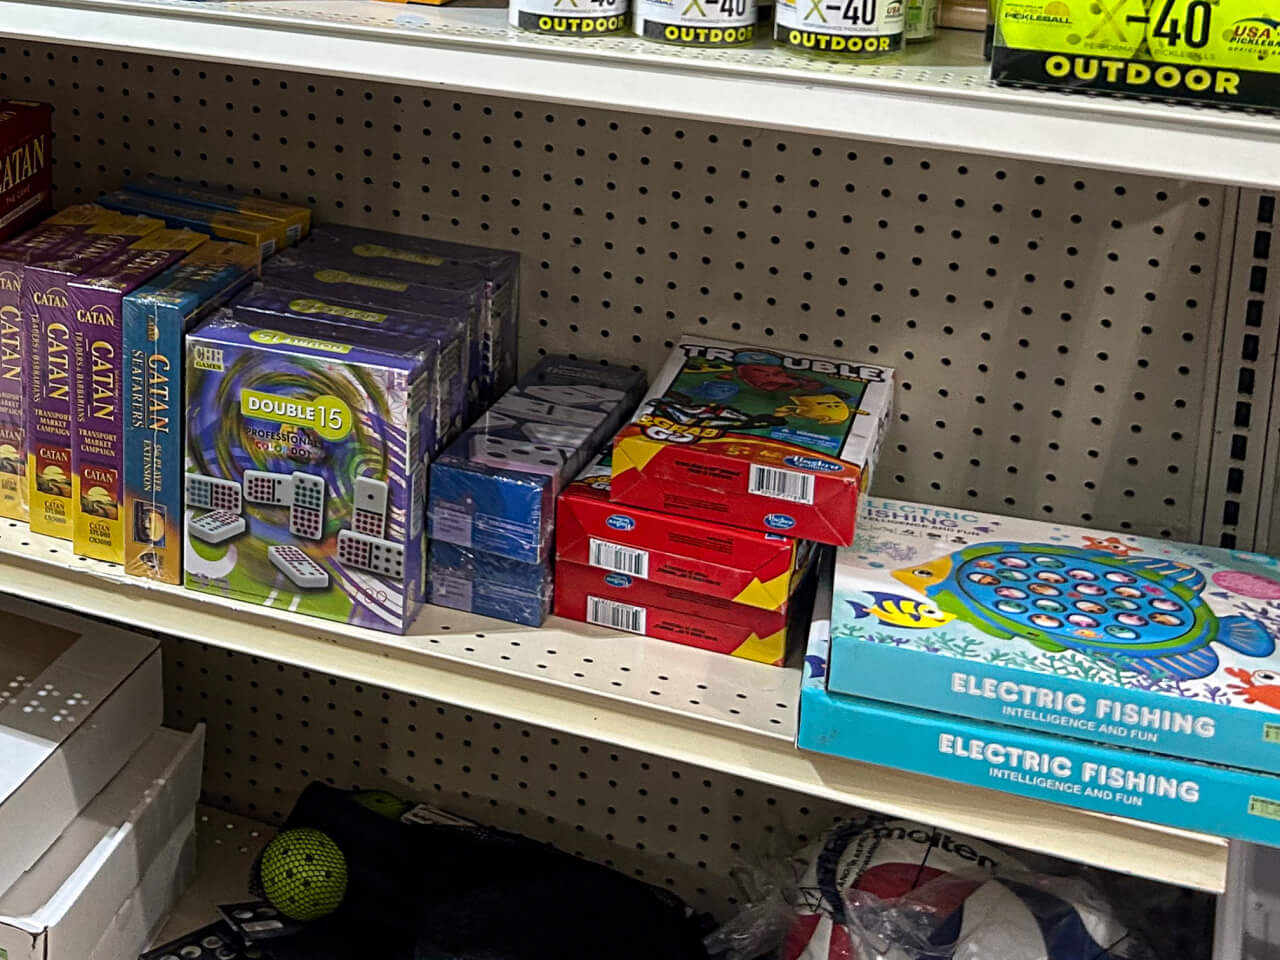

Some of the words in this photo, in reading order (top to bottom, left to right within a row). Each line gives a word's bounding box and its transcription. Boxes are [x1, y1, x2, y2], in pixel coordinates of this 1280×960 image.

[789, 30, 890, 52] OUTDOOR
[1045, 55, 1241, 96] OUTDOOR
[76, 309, 115, 327] CATAN
[0, 305, 21, 381] CATAN
[47, 322, 69, 401] CATAN
[90, 340, 115, 422] CATAN
[131, 349, 144, 429] SEAFARERS
[148, 353, 170, 434] CATAN
[248, 396, 315, 422] DOUBLE
[317, 405, 343, 430] 15
[78, 429, 118, 443] TRANSPORT
[80, 444, 116, 457] CAMPAIGN
[83, 436, 113, 450] MARKET
[246, 427, 320, 450] PROFESSIONAL
[255, 440, 288, 454] COLOR
[290, 445, 313, 458] DOT
[84, 468, 114, 484] CATAN
[951, 672, 1086, 715] ELECTRIC
[1095, 698, 1216, 738] FISHING
[1002, 705, 1096, 734] INTELLIGENCE
[1098, 725, 1126, 739] AND
[1129, 729, 1159, 743] FUN
[938, 733, 1073, 779] ELECTRIC
[1081, 760, 1200, 804] FISHING
[989, 767, 1082, 797] INTELLIGENCE
[1084, 786, 1113, 801] AND
[1115, 792, 1144, 807] FUN
[872, 824, 1001, 869] molten
